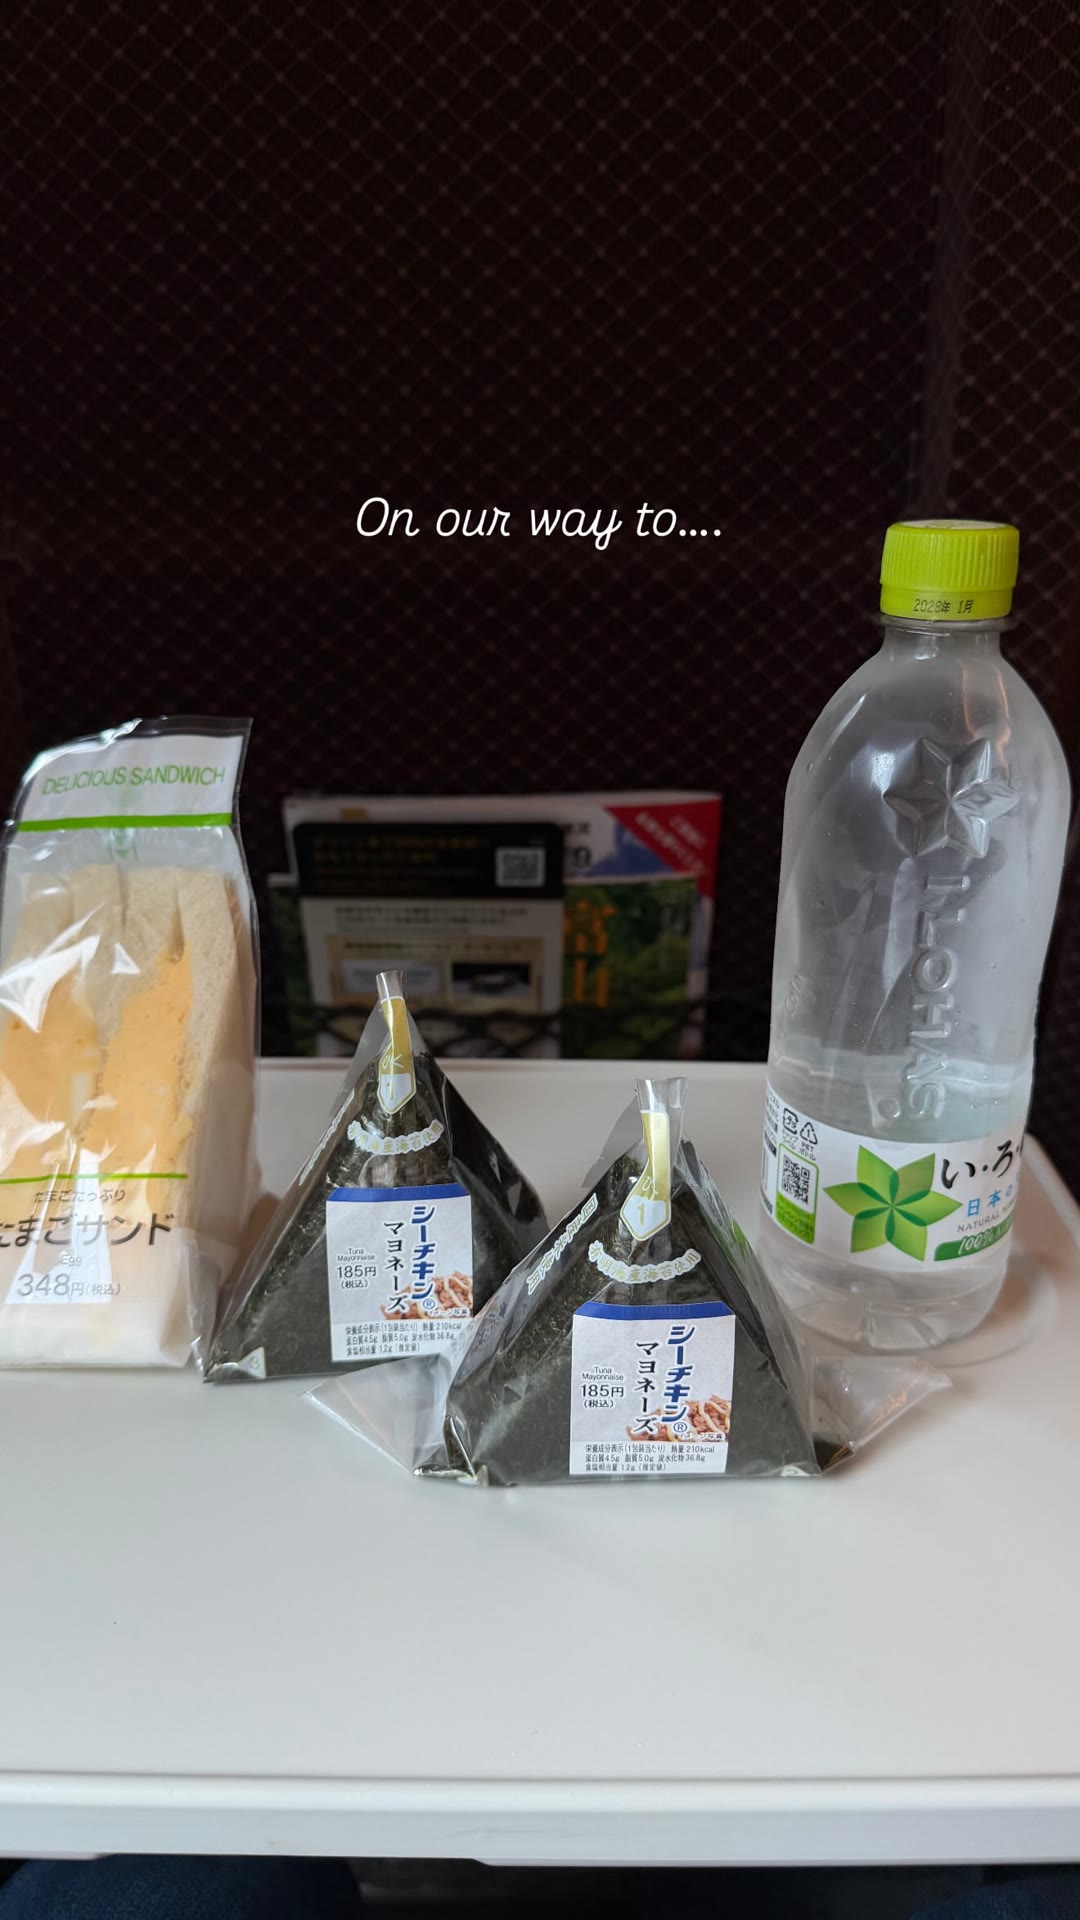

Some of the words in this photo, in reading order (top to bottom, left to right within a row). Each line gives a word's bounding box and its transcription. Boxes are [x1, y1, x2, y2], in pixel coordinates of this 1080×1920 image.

[913, 598, 950, 614] 2028年
[957, 599, 974, 614] 1月
[42, 766, 128, 795] DELICIOUS
[130, 765, 226, 786] SANDWICH
[637, 1203, 645, 1227] 1
[957, 1211, 1001, 1233] NATURAL
[958, 1226, 994, 1255] 100%
[60, 1253, 82, 1267] Egg
[337, 1254, 375, 1262] Mayonnaise
[337, 1265, 377, 1279] 185円
[384, 1222, 408, 1312] マヨネーズ
[582, 1373, 624, 1381] Mayonnaise
[594, 1366, 612, 1374] Tuna
[581, 1384, 624, 1398] 185円
[633, 1341, 659, 1433] マヨネーズ
[583, 1399, 614, 1408] (税込)
[686, 1444, 715, 1453] 210kcal
